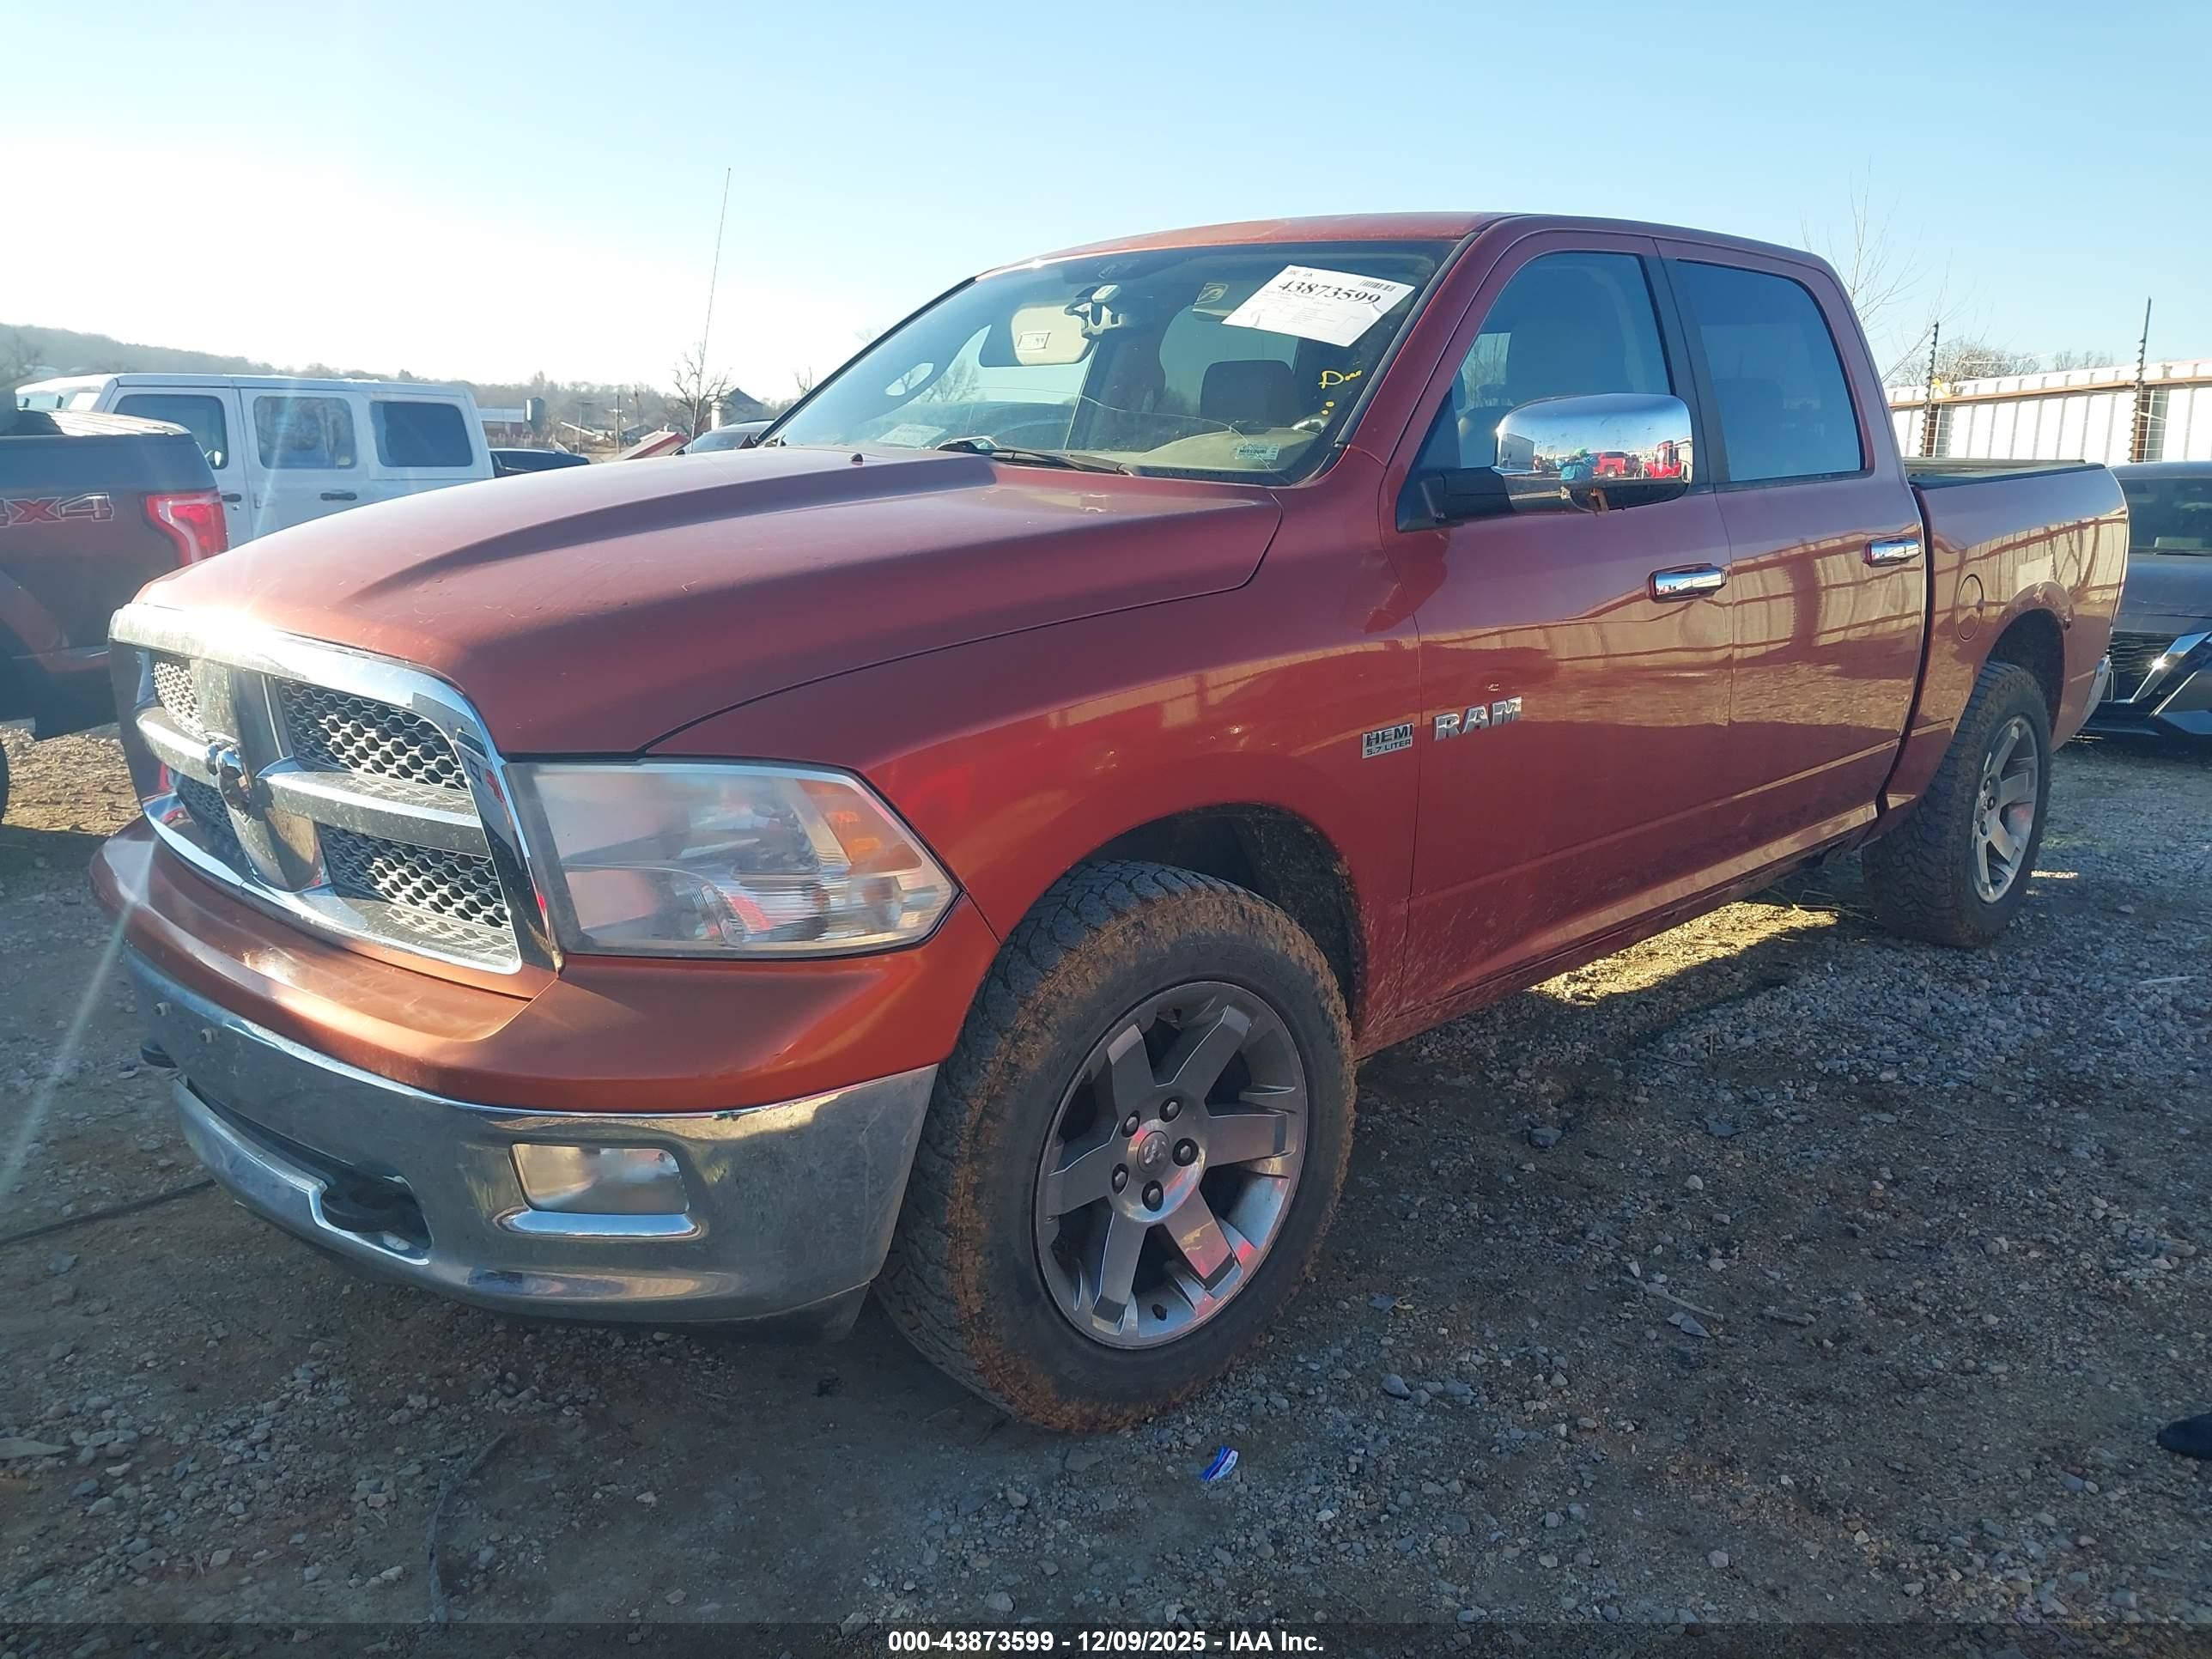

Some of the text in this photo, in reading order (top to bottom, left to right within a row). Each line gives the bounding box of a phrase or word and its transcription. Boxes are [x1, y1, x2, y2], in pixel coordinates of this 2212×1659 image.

[1279, 280, 1382, 305] 43873599
[0, 492, 113, 527] X4
[1434, 696, 1522, 742] RAM
[1366, 724, 1413, 748] HEMI
[1366, 739, 1411, 756] 5.7 LITER
